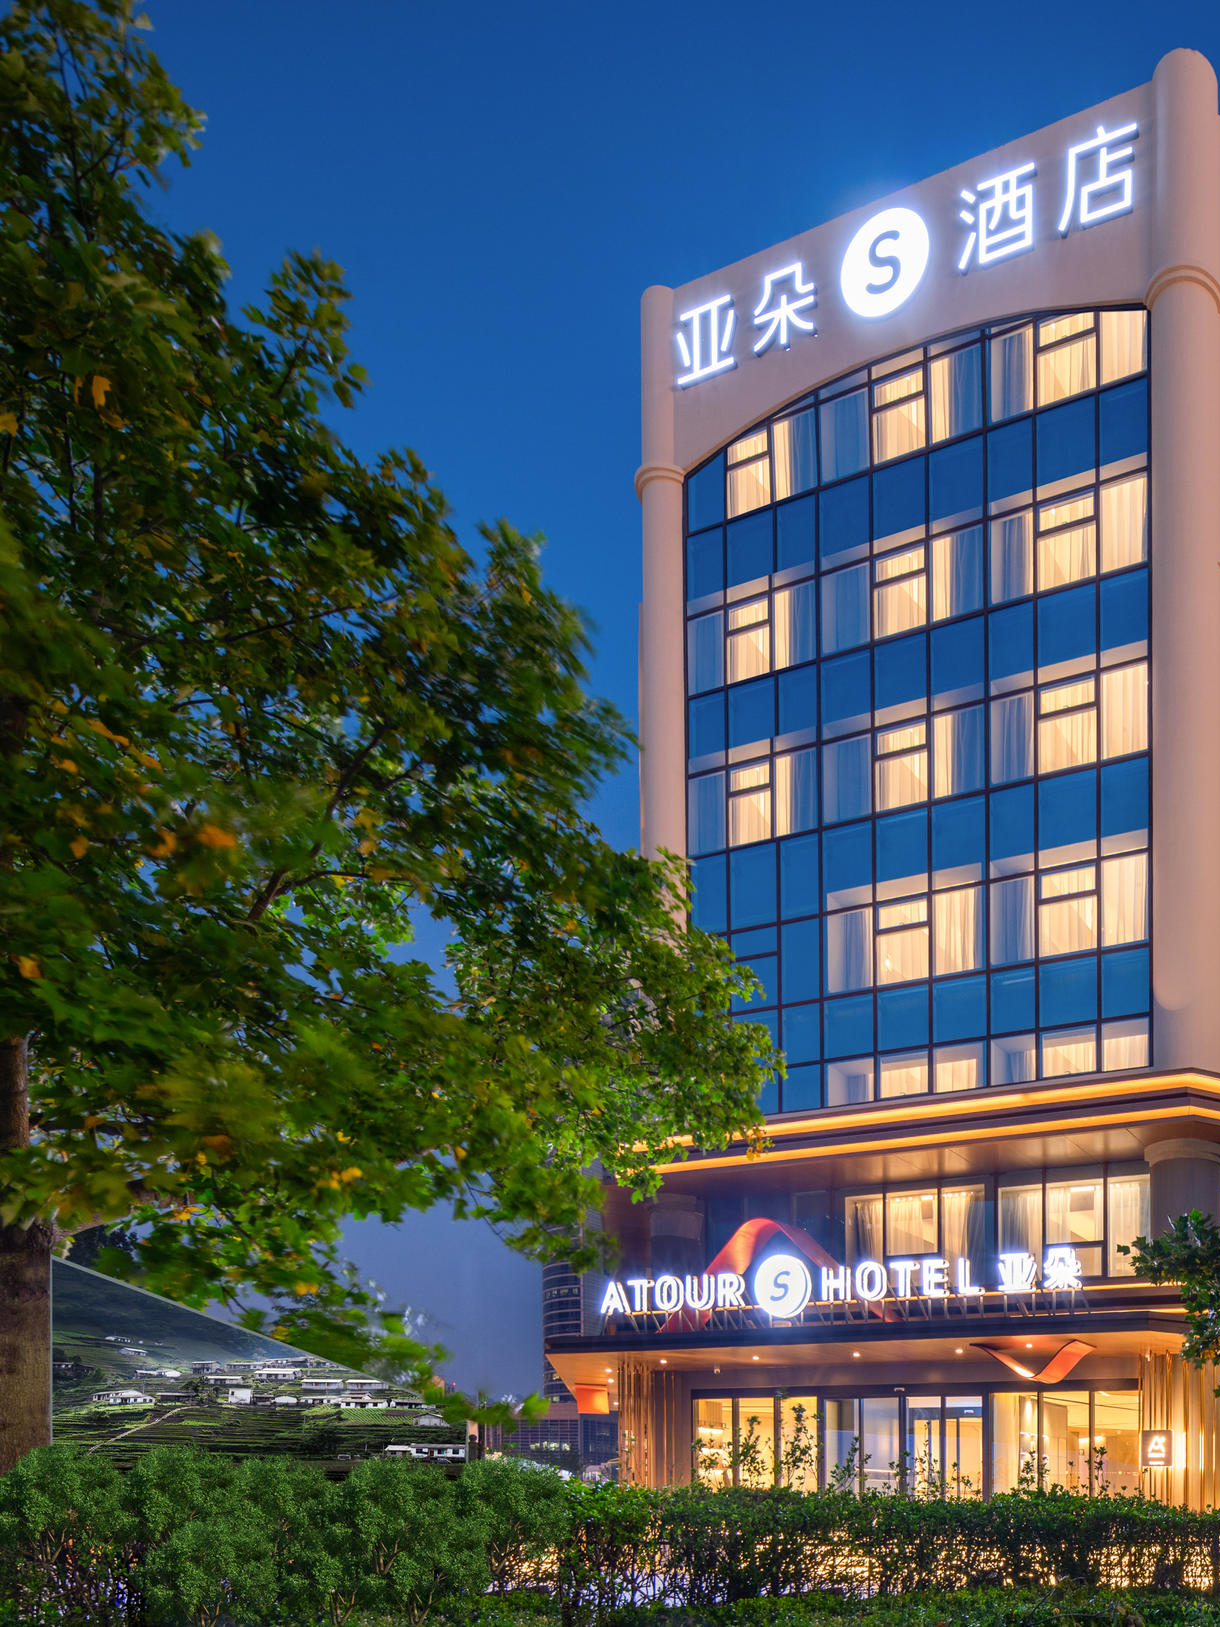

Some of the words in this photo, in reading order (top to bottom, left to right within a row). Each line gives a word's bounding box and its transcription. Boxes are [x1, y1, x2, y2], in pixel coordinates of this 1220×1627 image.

[676, 261, 815, 386] 亚朵
[958, 124, 1139, 271] 酒店
[601, 1272, 746, 1315] ATOUR
[821, 1257, 986, 1301] HOTEL
[998, 1247, 1082, 1293] 亚朵
